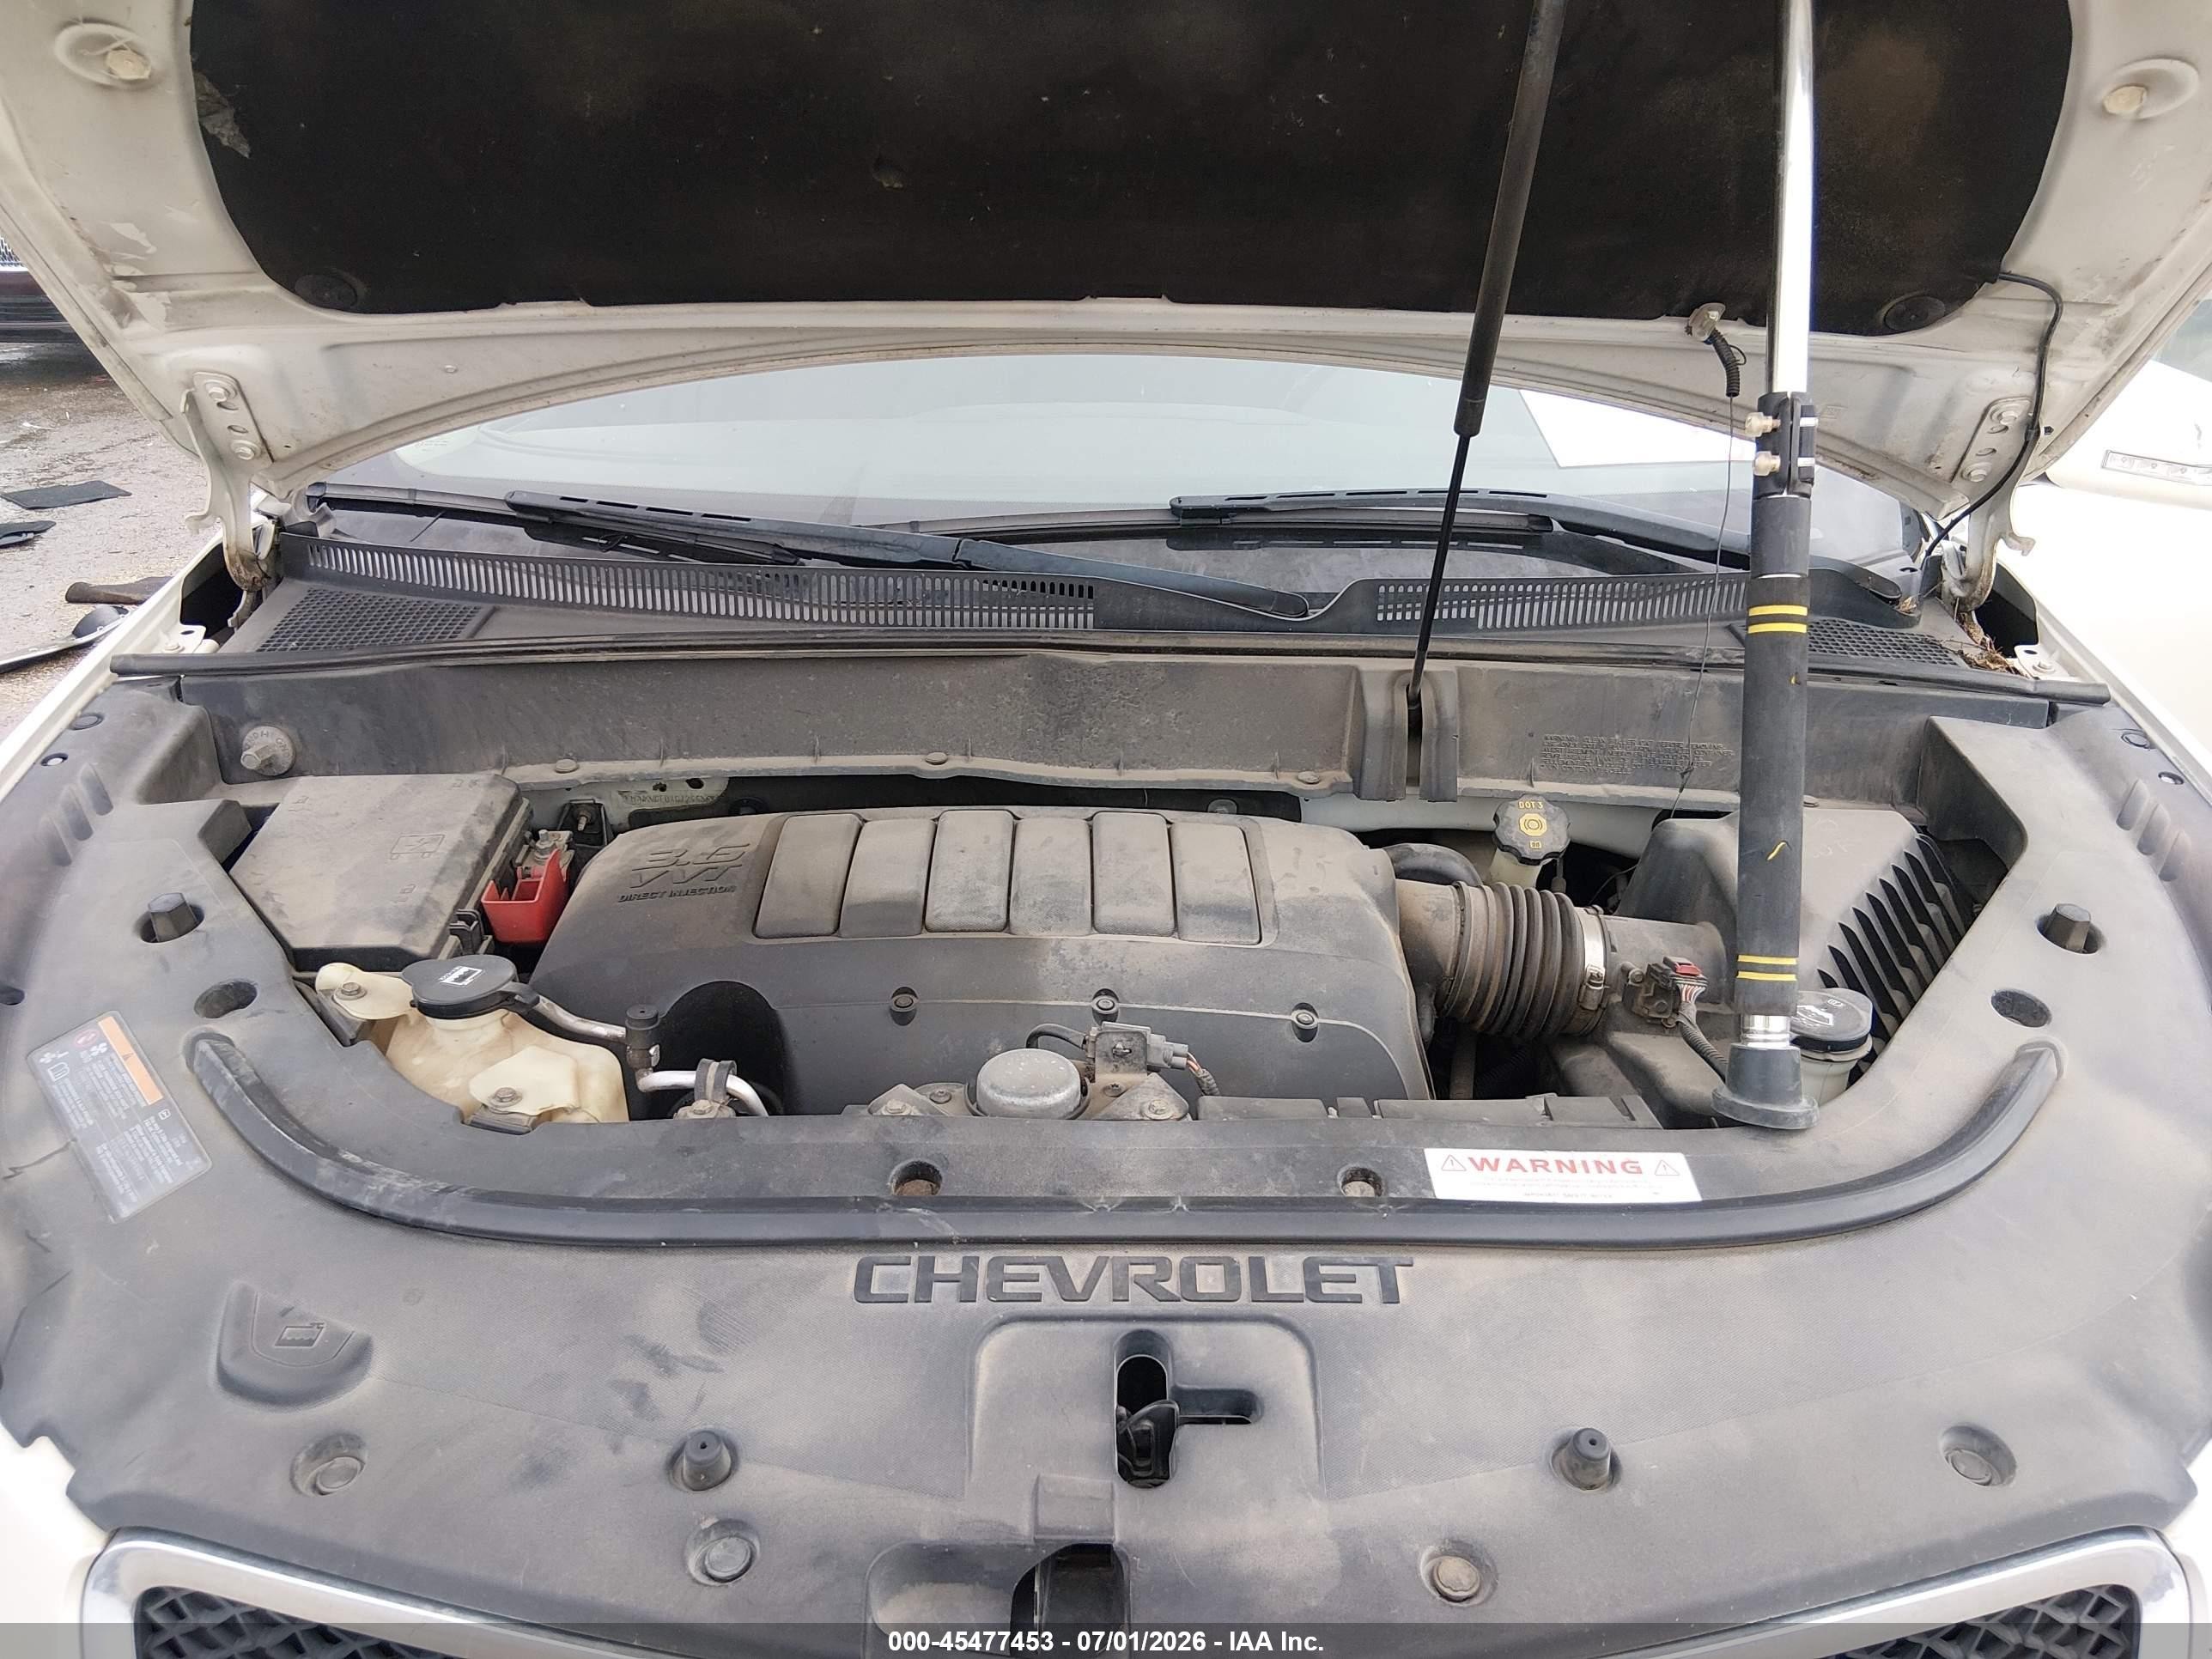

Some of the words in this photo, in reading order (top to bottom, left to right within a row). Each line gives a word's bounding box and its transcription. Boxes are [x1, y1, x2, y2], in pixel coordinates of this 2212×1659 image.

[1518, 800, 1535, 809] DOT
[618, 890, 667, 902] DIRECT
[669, 885, 737, 898] INJECTION
[1468, 1157, 1644, 1175] WARNING
[854, 1255, 1414, 1304] CHEVROLET
